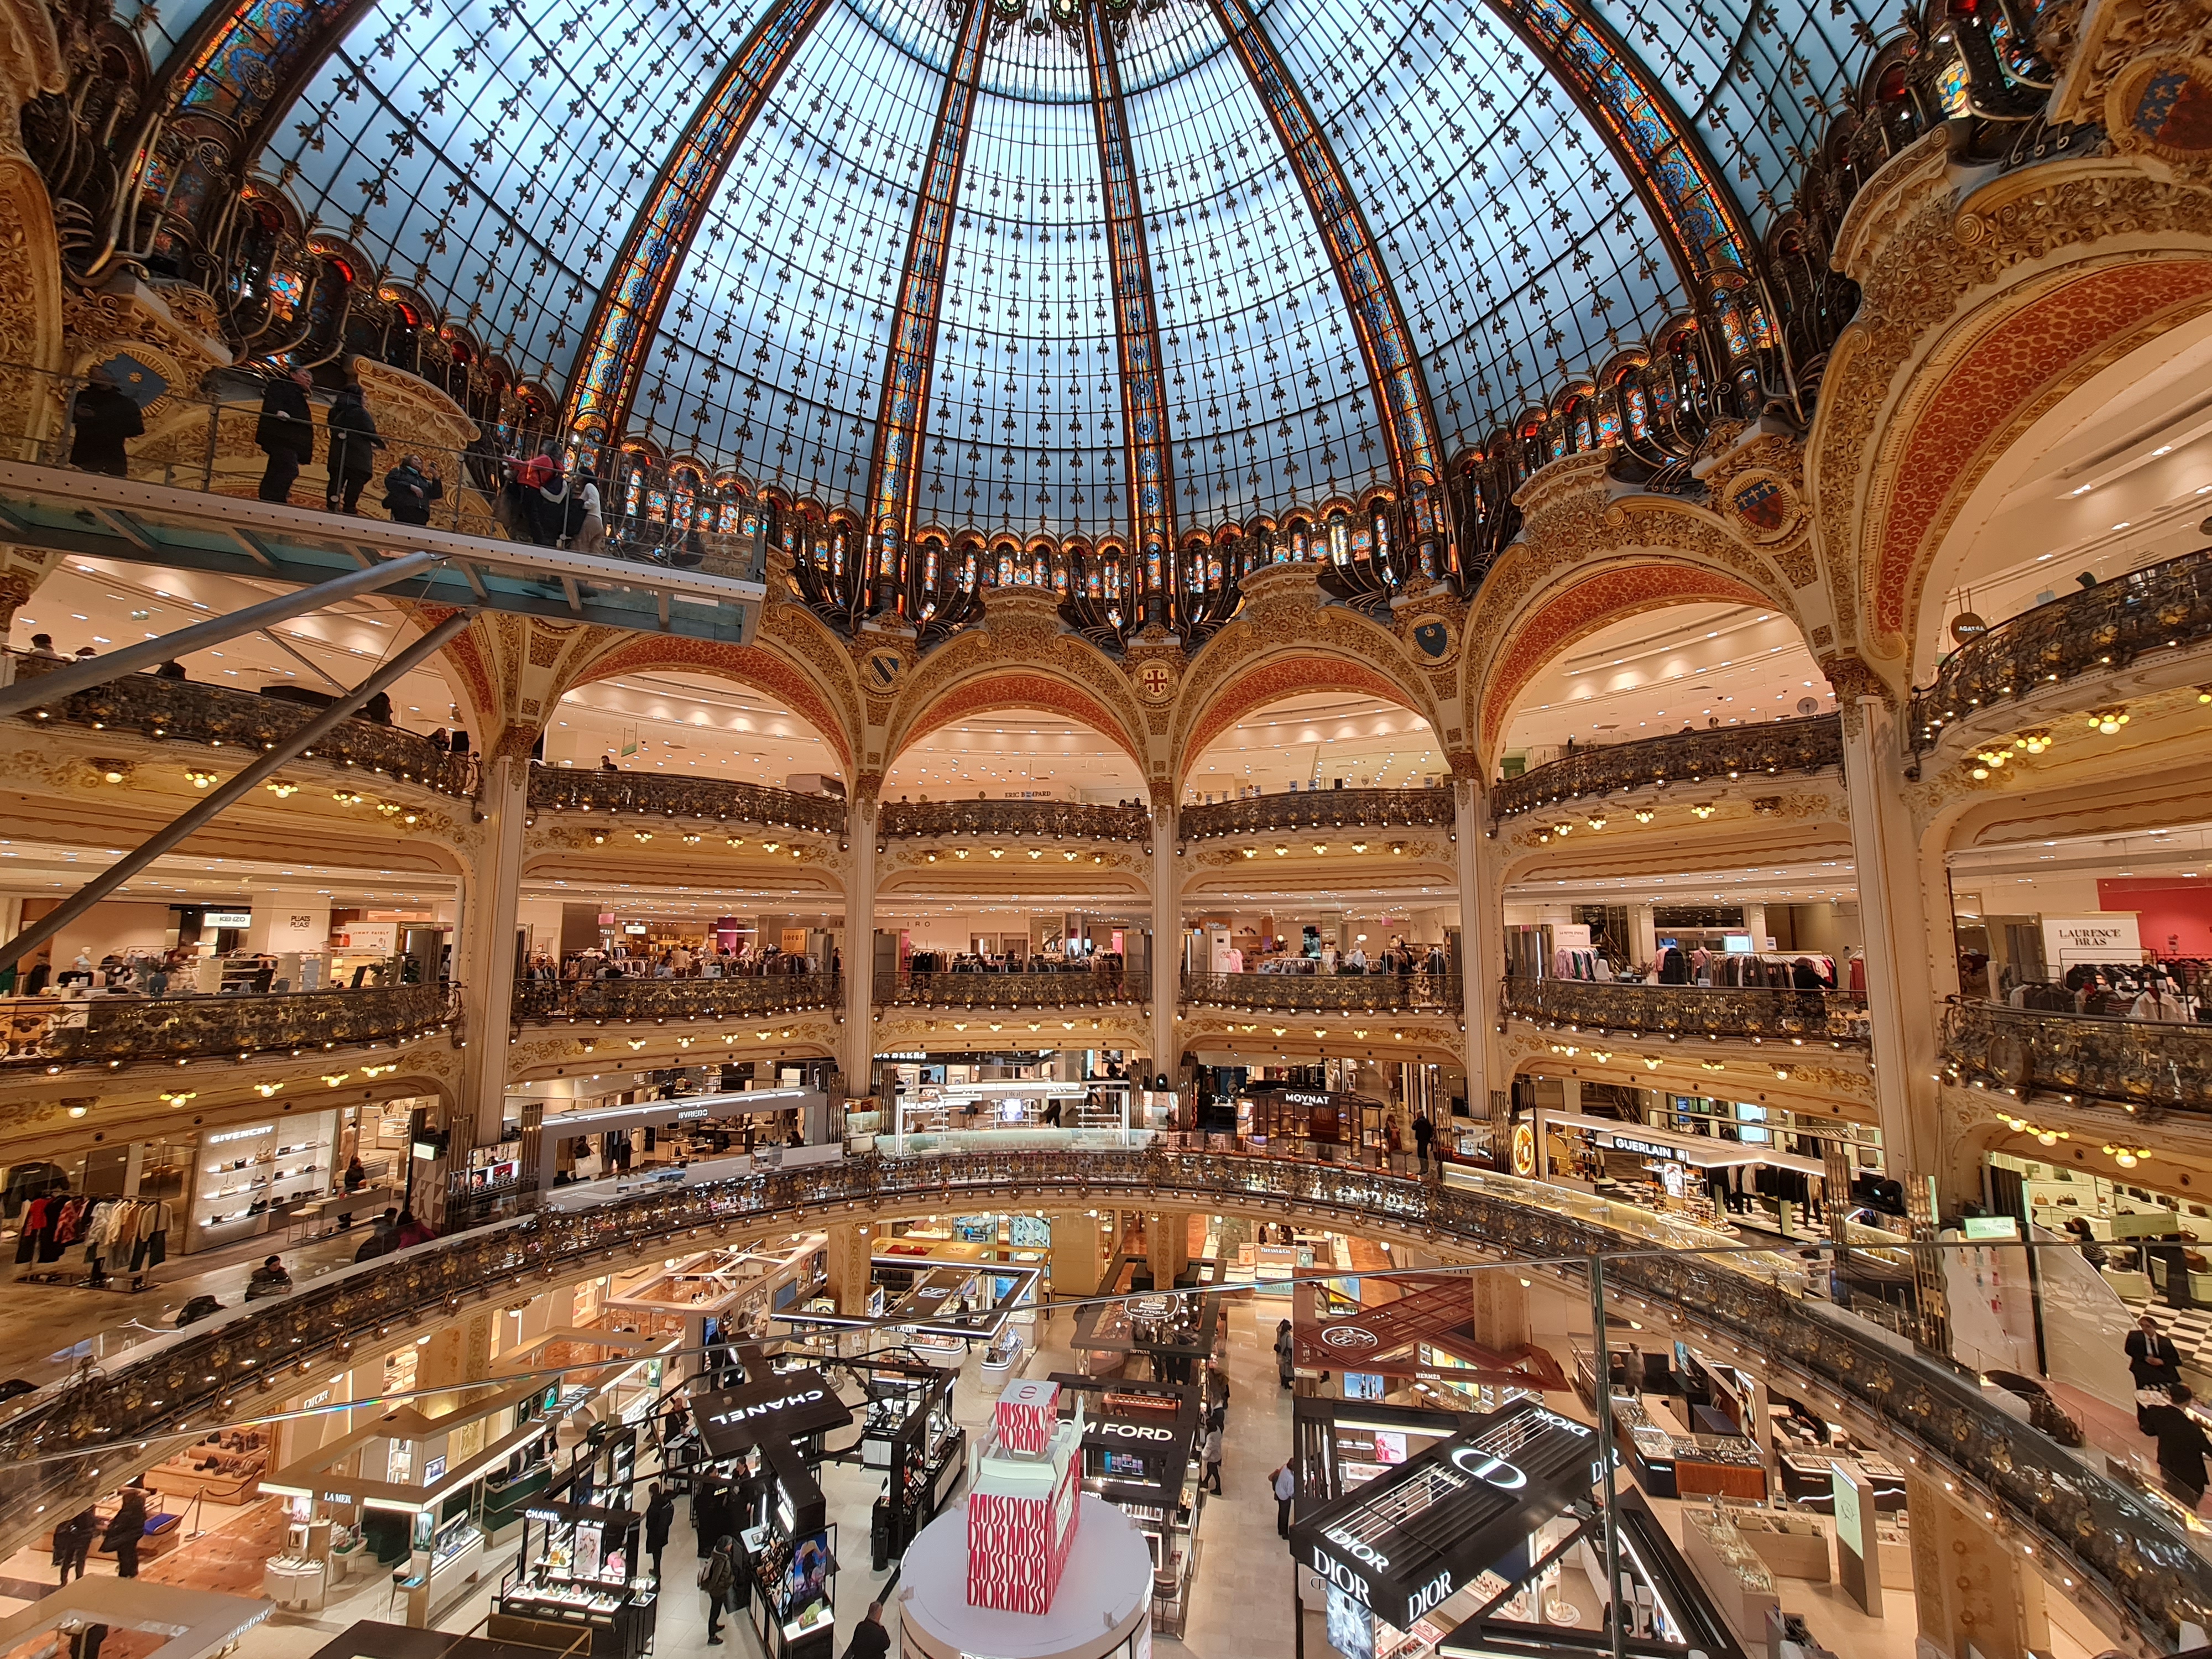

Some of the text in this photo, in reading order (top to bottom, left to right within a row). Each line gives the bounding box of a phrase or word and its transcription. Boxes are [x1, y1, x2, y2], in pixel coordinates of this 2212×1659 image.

[2059, 929, 2122, 938] LAURENCE
[2075, 938, 2107, 946] BRAS
[1285, 1093, 1330, 1104] MOYNAT
[678, 1109, 708, 1119] BYREDO
[210, 1125, 274, 1143] GIVENCHY
[1615, 1137, 1672, 1158] GUERLAIN
[304, 1389, 330, 1410] DIOR
[563, 1399, 585, 1420] LA MER
[709, 1389, 825, 1426] CHANEL
[1102, 1422, 1173, 1441] FORD
[1534, 1407, 1591, 1437] DIOR
[324, 1491, 352, 1504] LA MER
[776, 1477, 795, 1518] CHANEL
[525, 1509, 560, 1522] CHANEL
[1325, 1528, 1389, 1573] DIOR
[1313, 1546, 1371, 1608] DIOR
[1408, 1571, 1453, 1623] DIOR
